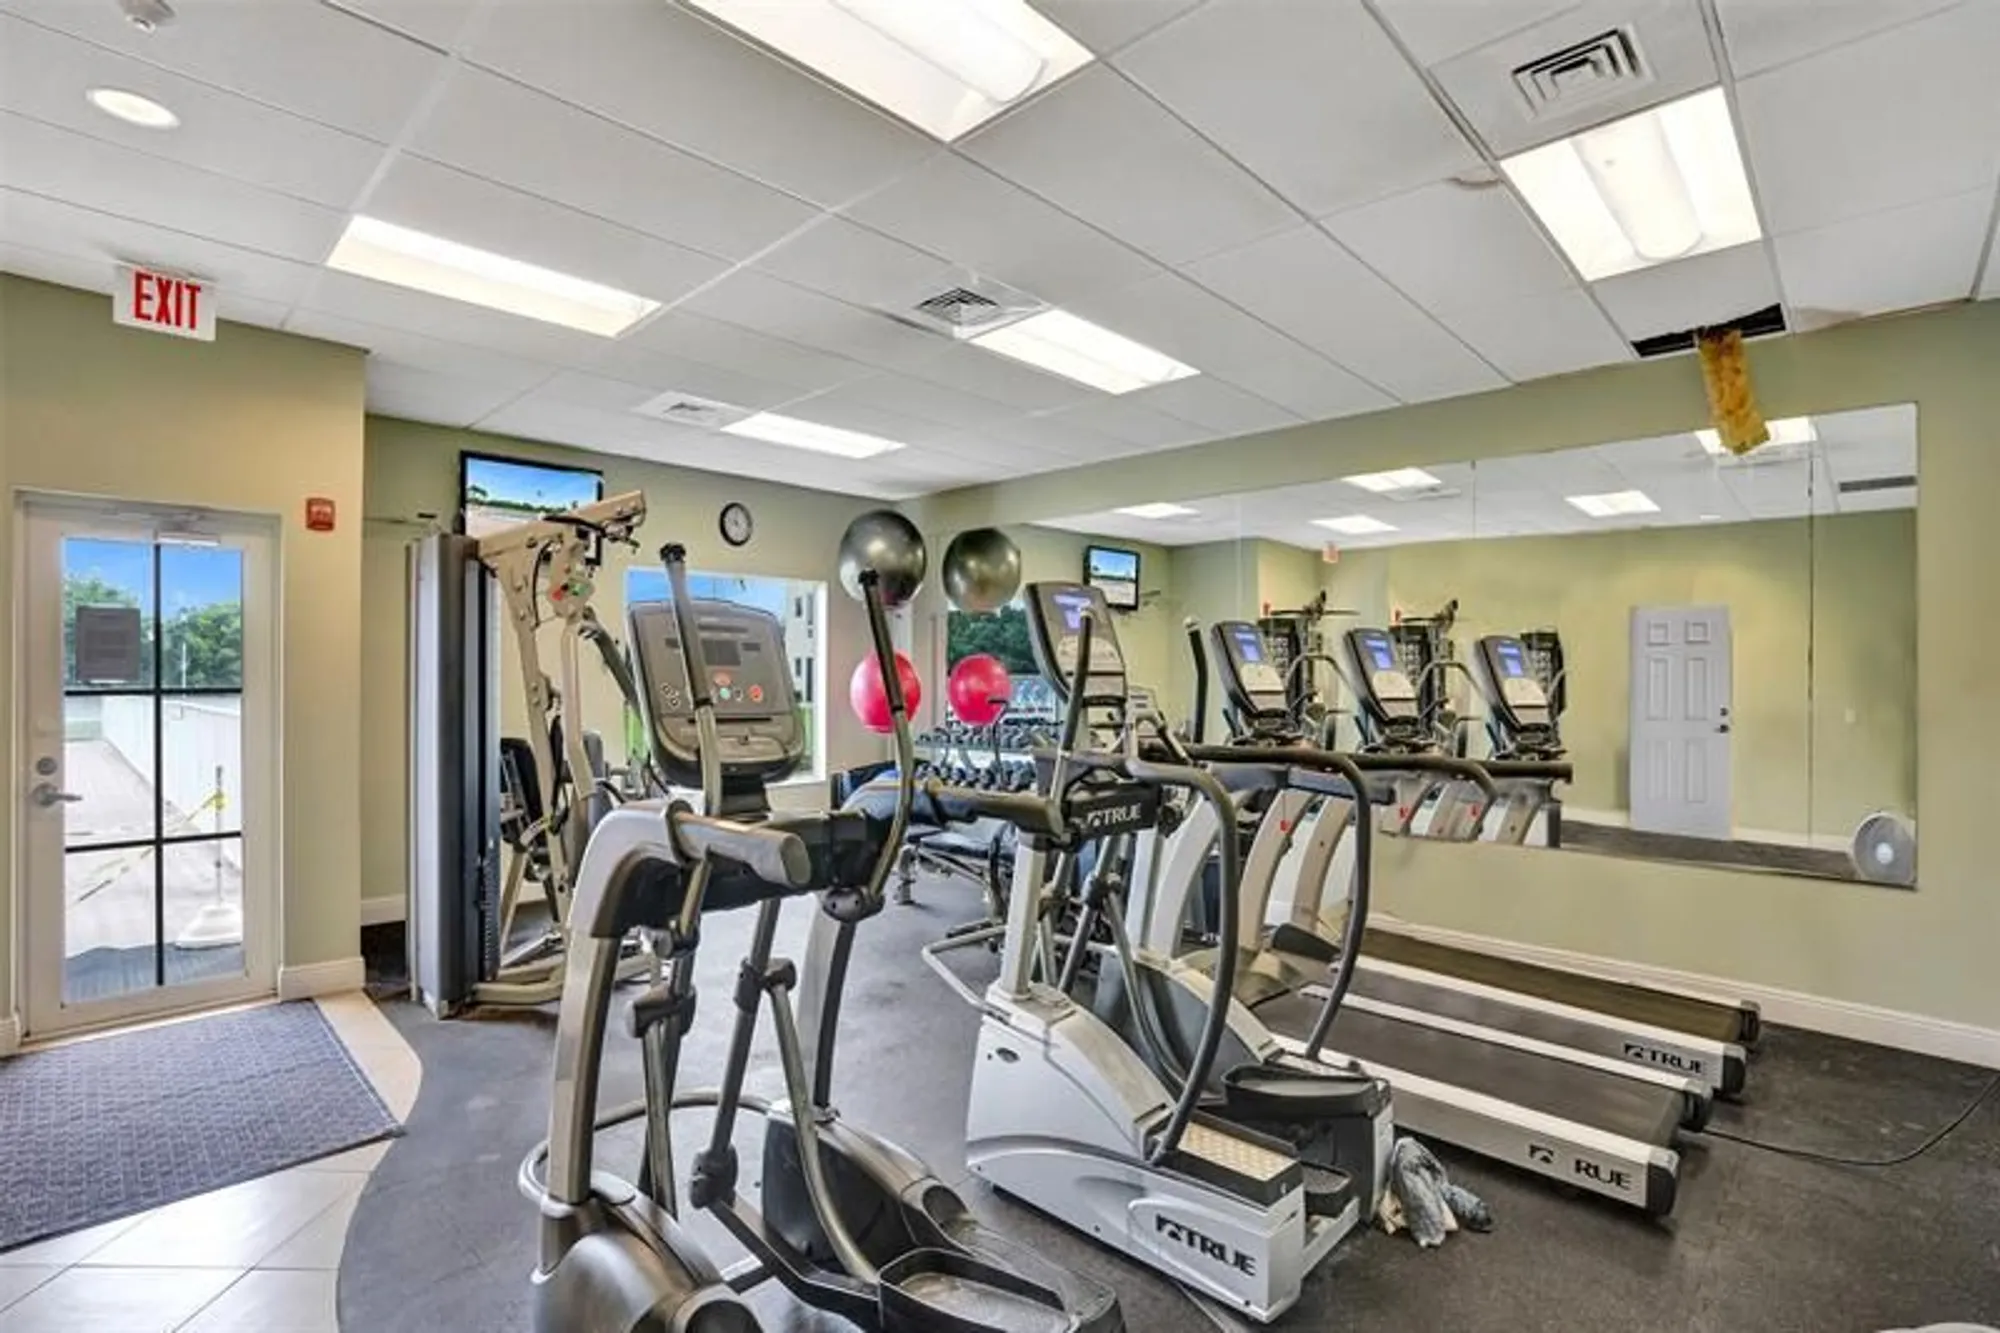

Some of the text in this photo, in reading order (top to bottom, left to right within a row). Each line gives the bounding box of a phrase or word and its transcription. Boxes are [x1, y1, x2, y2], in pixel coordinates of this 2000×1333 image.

[135, 271, 201, 329] EXIT
[1100, 803, 1141, 825] TRUE
[1186, 1226, 1256, 1276] TRUE
